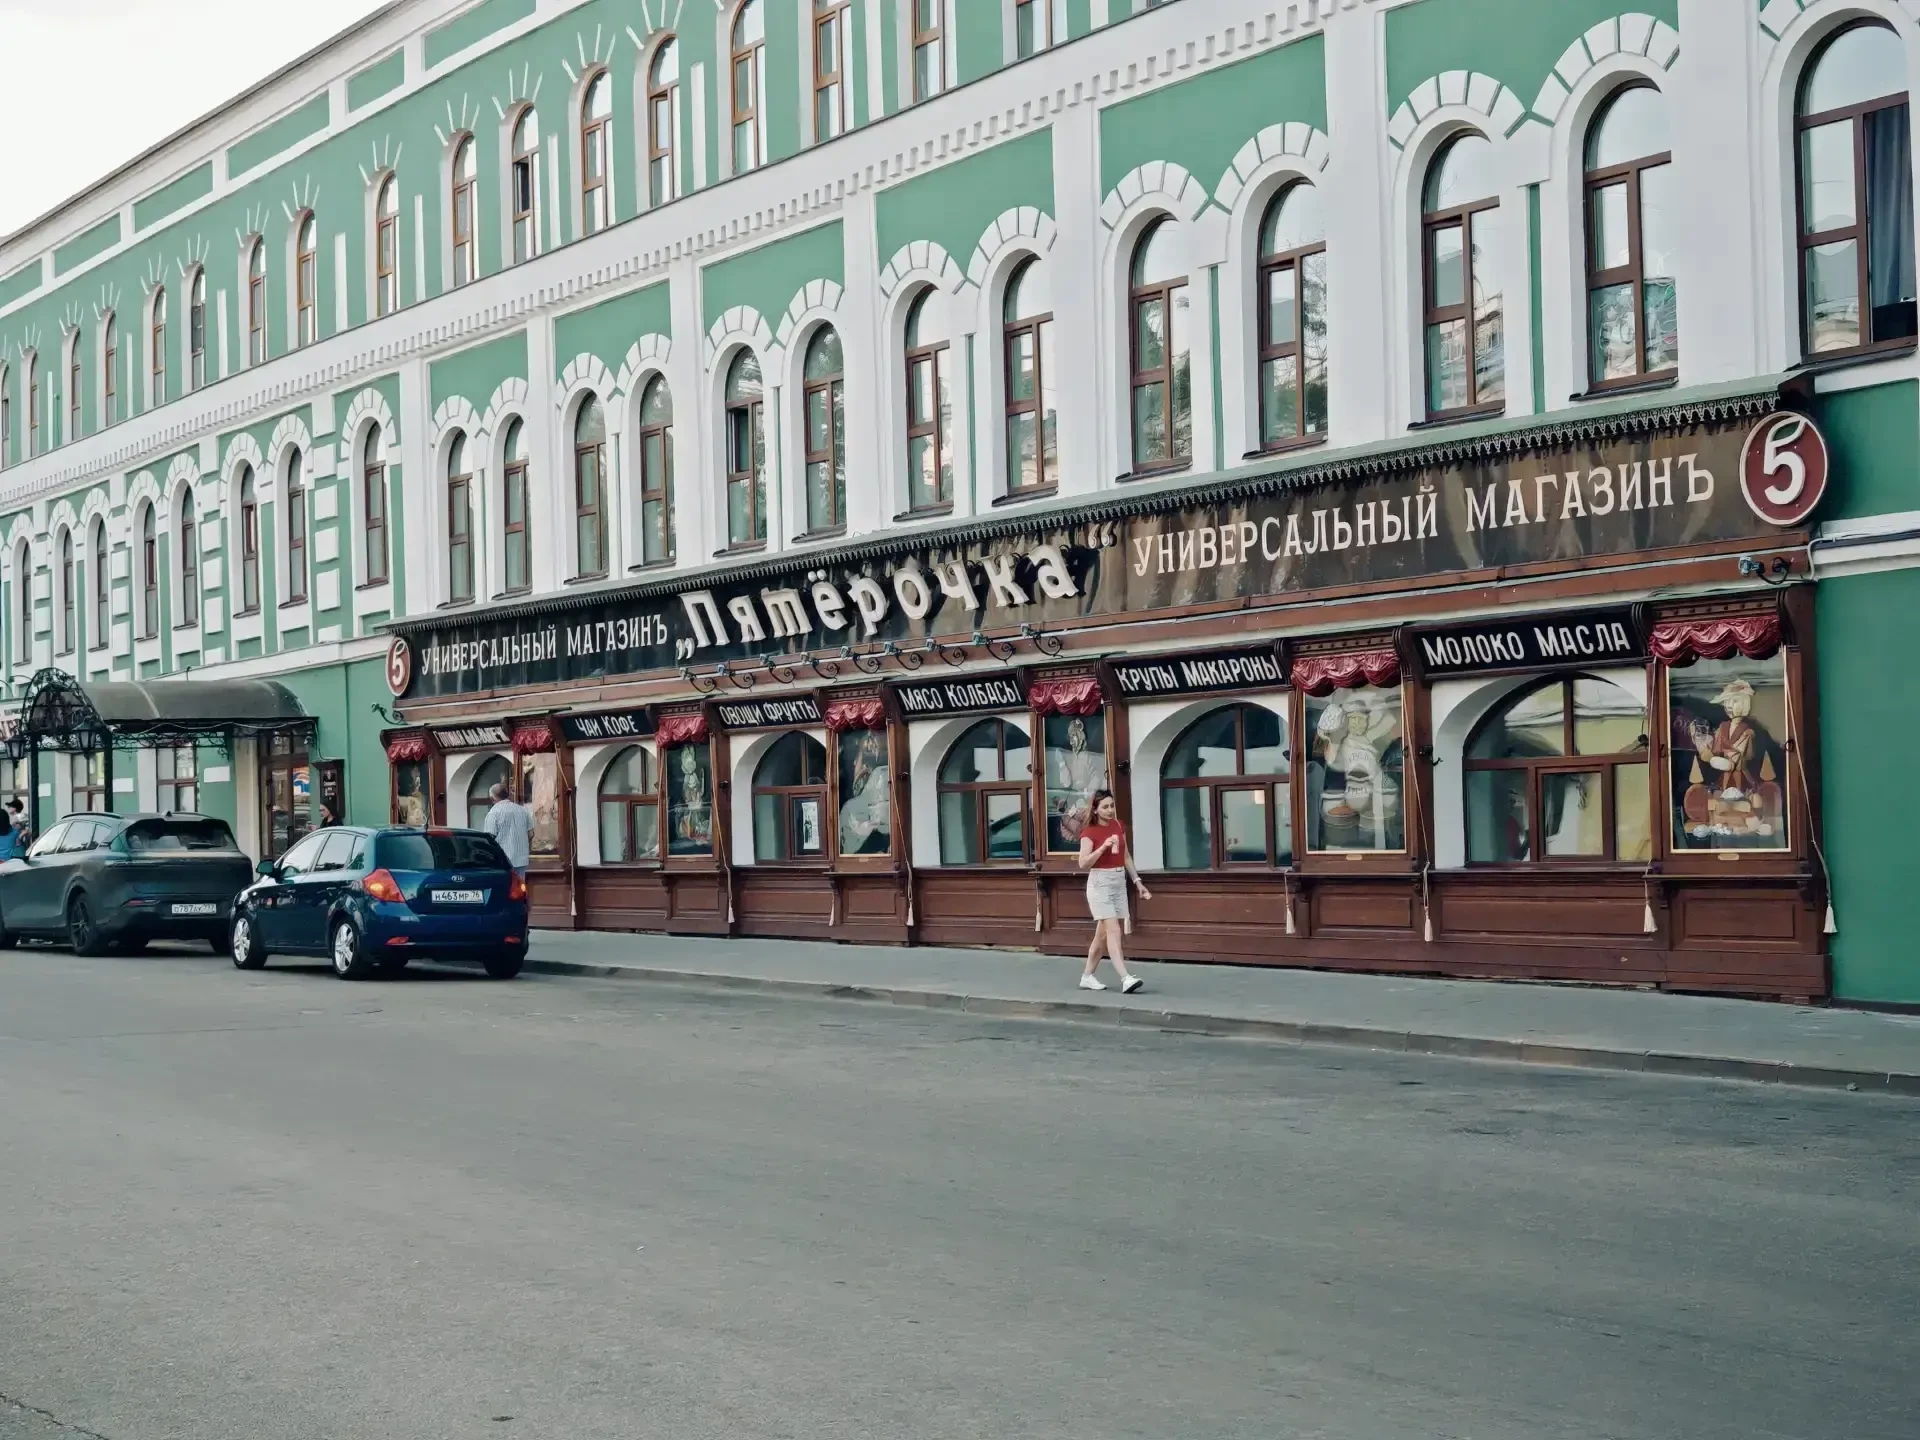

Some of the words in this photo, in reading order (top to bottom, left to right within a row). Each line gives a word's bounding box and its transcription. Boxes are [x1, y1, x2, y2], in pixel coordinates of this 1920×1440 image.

[1762, 415, 1813, 506] 5
[1132, 485, 1439, 577] УНИВЕРСАЛЬНЫЙ
[1464, 453, 1715, 533] МАГАЗИНЪ
[421, 624, 557, 676] УНИВЕРСАЛЬНЫЙ
[566, 613, 668, 652] МАГАЗИНЪ
[1421, 631, 1526, 666] МОЛОКО
[1533, 622, 1632, 657] МАСЛА
[1114, 665, 1179, 693] КРУПЫ
[1179, 655, 1283, 688] МАКАРОНЫ
[718, 704, 765, 726] ОВОЩИ
[763, 699, 821, 722] ФРУКТЫ
[898, 687, 945, 711] МЯСО
[948, 680, 1022, 708] КОЛБАСЫ
[600, 715, 639, 735] КОФЕ
